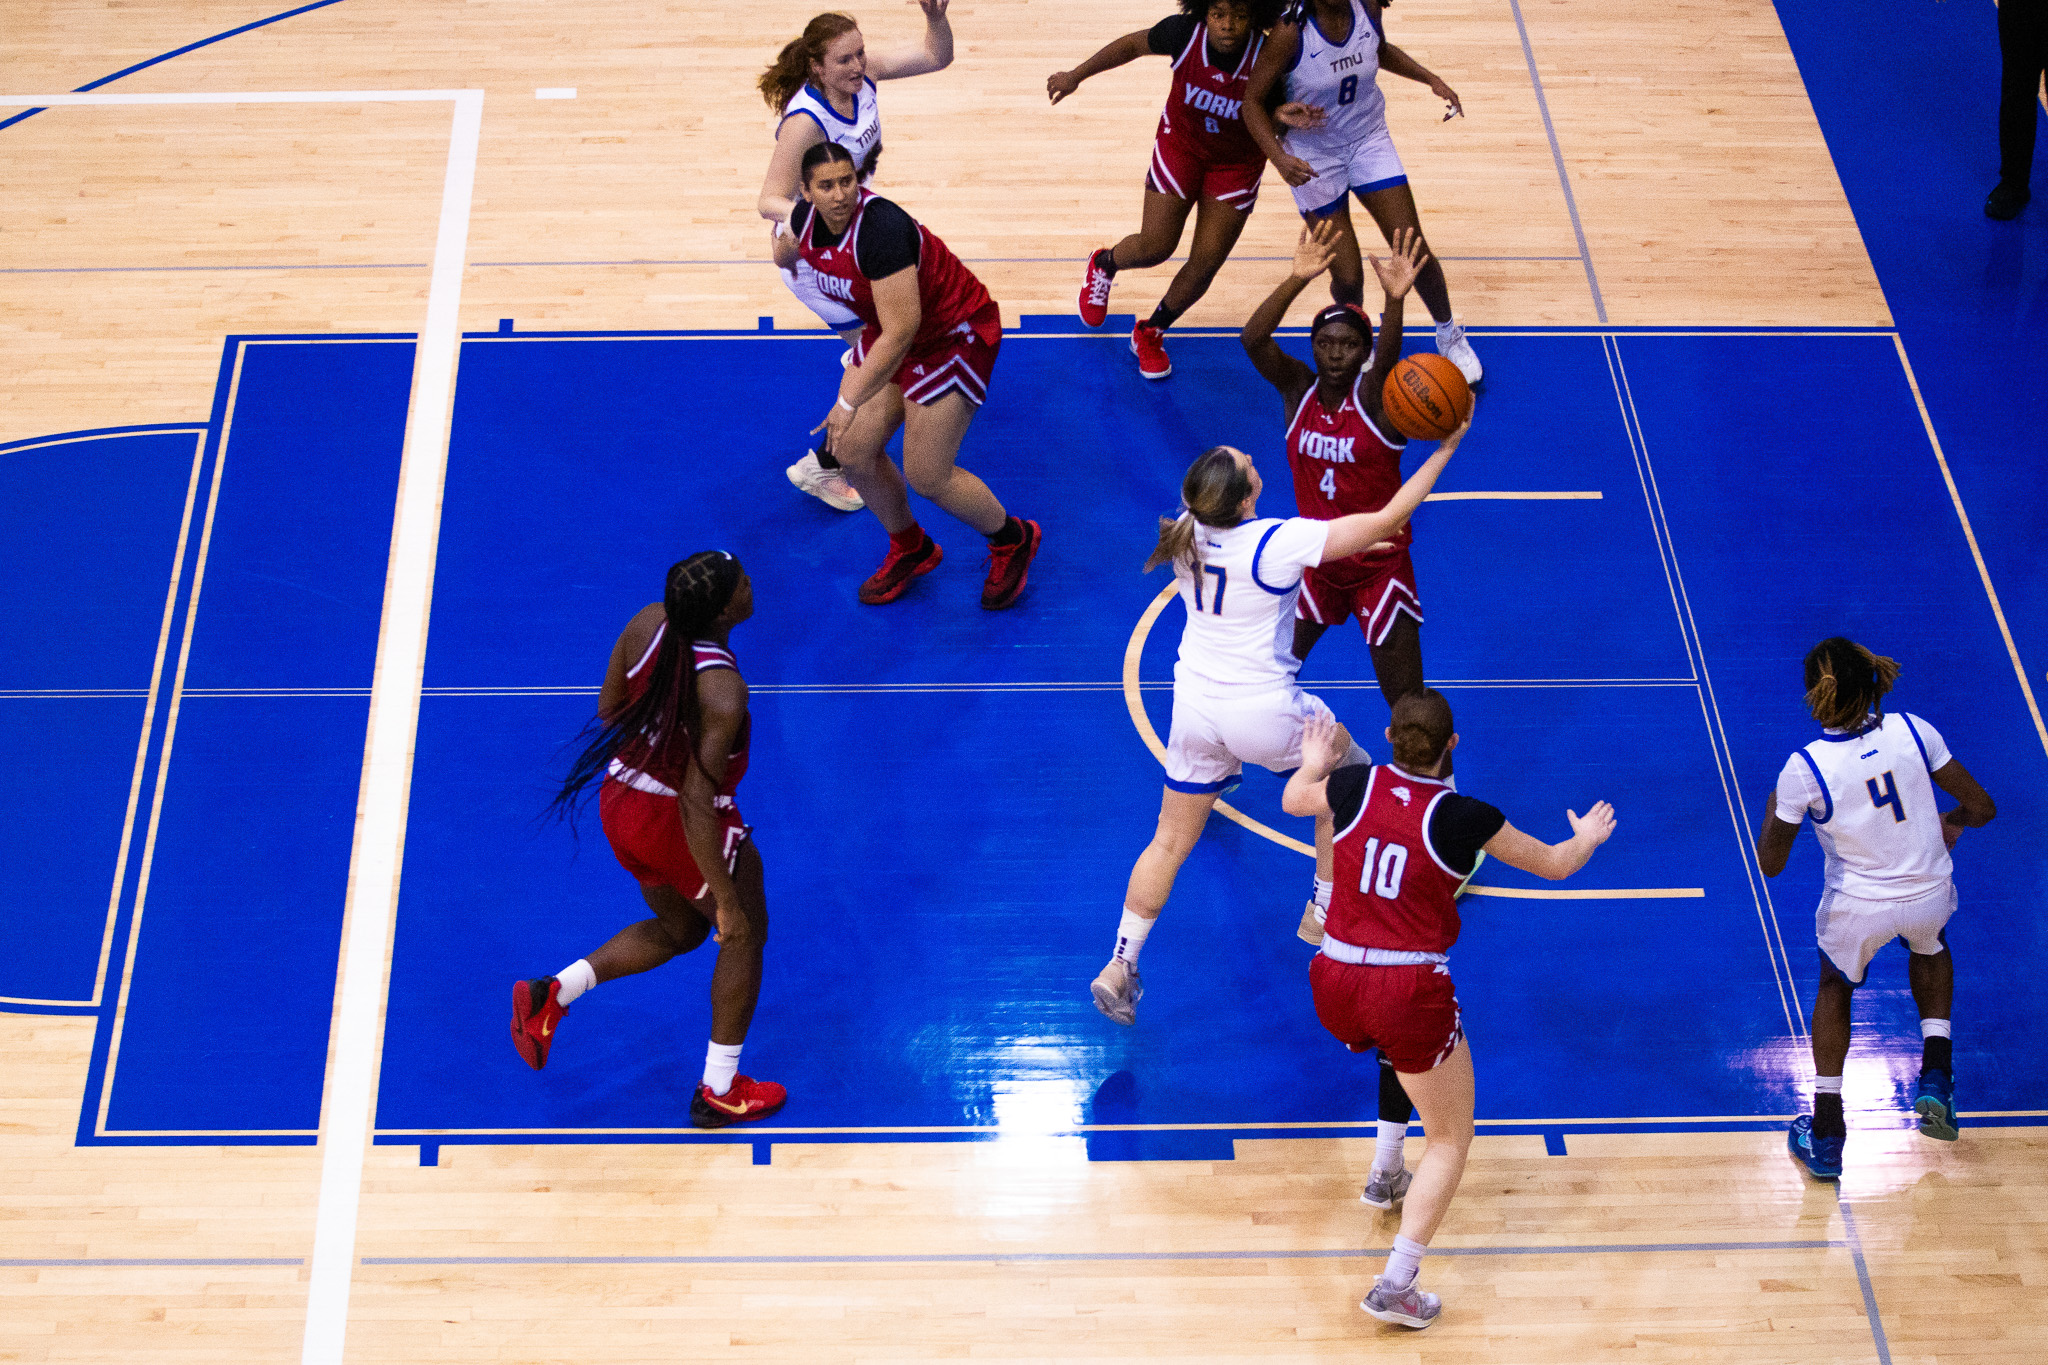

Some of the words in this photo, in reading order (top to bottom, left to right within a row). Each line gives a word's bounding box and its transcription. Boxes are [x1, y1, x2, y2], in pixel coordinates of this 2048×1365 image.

[1330, 52, 1363, 73] TMU
[1184, 82, 1242, 120] YORK
[1338, 74, 1358, 106] 8
[855, 120, 878, 148] TMU
[814, 269, 856, 302] ORK
[1402, 368, 1442, 420] Wilson
[1298, 428, 1356, 463] YORK
[1319, 468, 1337, 500] 4
[1190, 561, 1227, 616] 17
[1865, 769, 1907, 824] 4
[1359, 836, 1408, 900] 10
